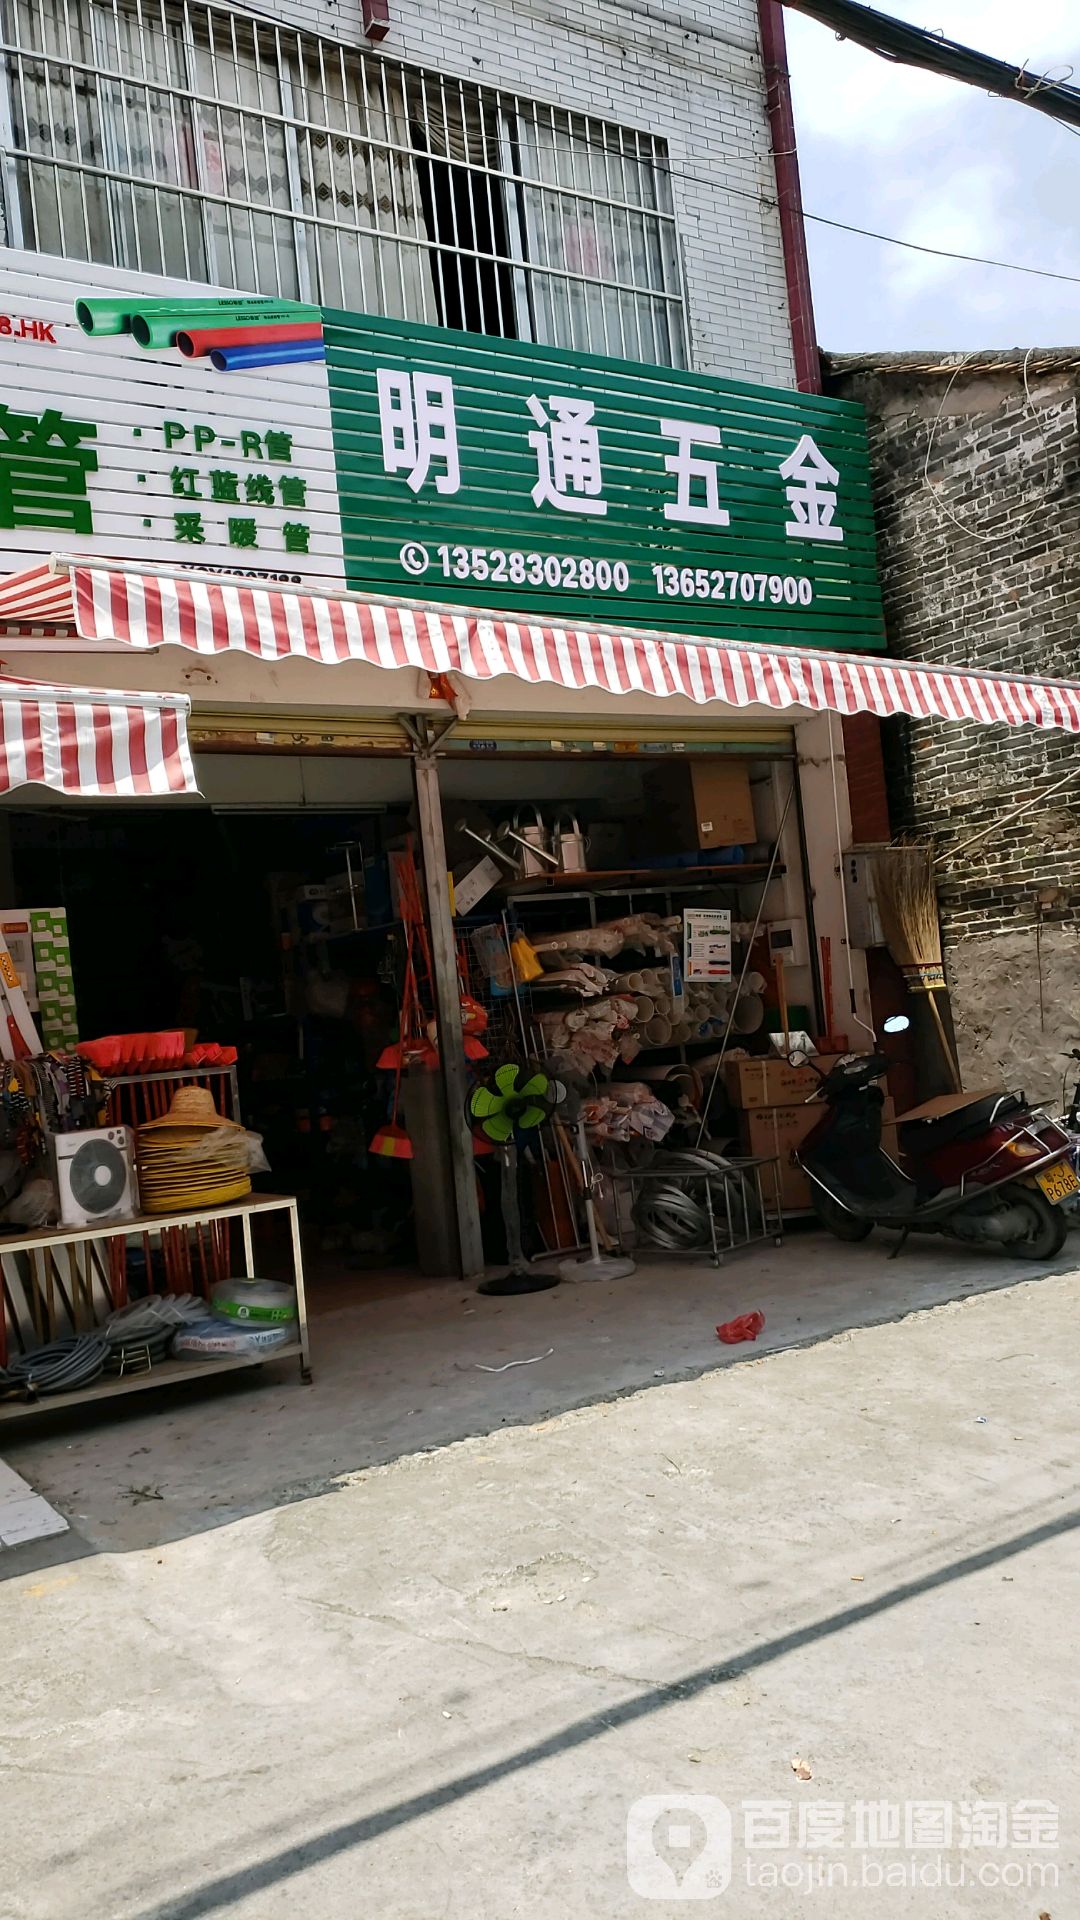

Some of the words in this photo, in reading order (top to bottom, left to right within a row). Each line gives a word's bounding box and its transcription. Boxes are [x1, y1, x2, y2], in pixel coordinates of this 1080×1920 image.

[163, 421, 293, 463] PP-R管
[376, 368, 843, 541] 明通五金
[0, 403, 98, 534] 管
[171, 466, 307, 508] 红蓝线管
[174, 512, 310, 554] 采暖管
[436, 545, 629, 592] 13528302800
[652, 563, 813, 605] 13652707900
[1047, 1175, 1078, 1200] P678E
